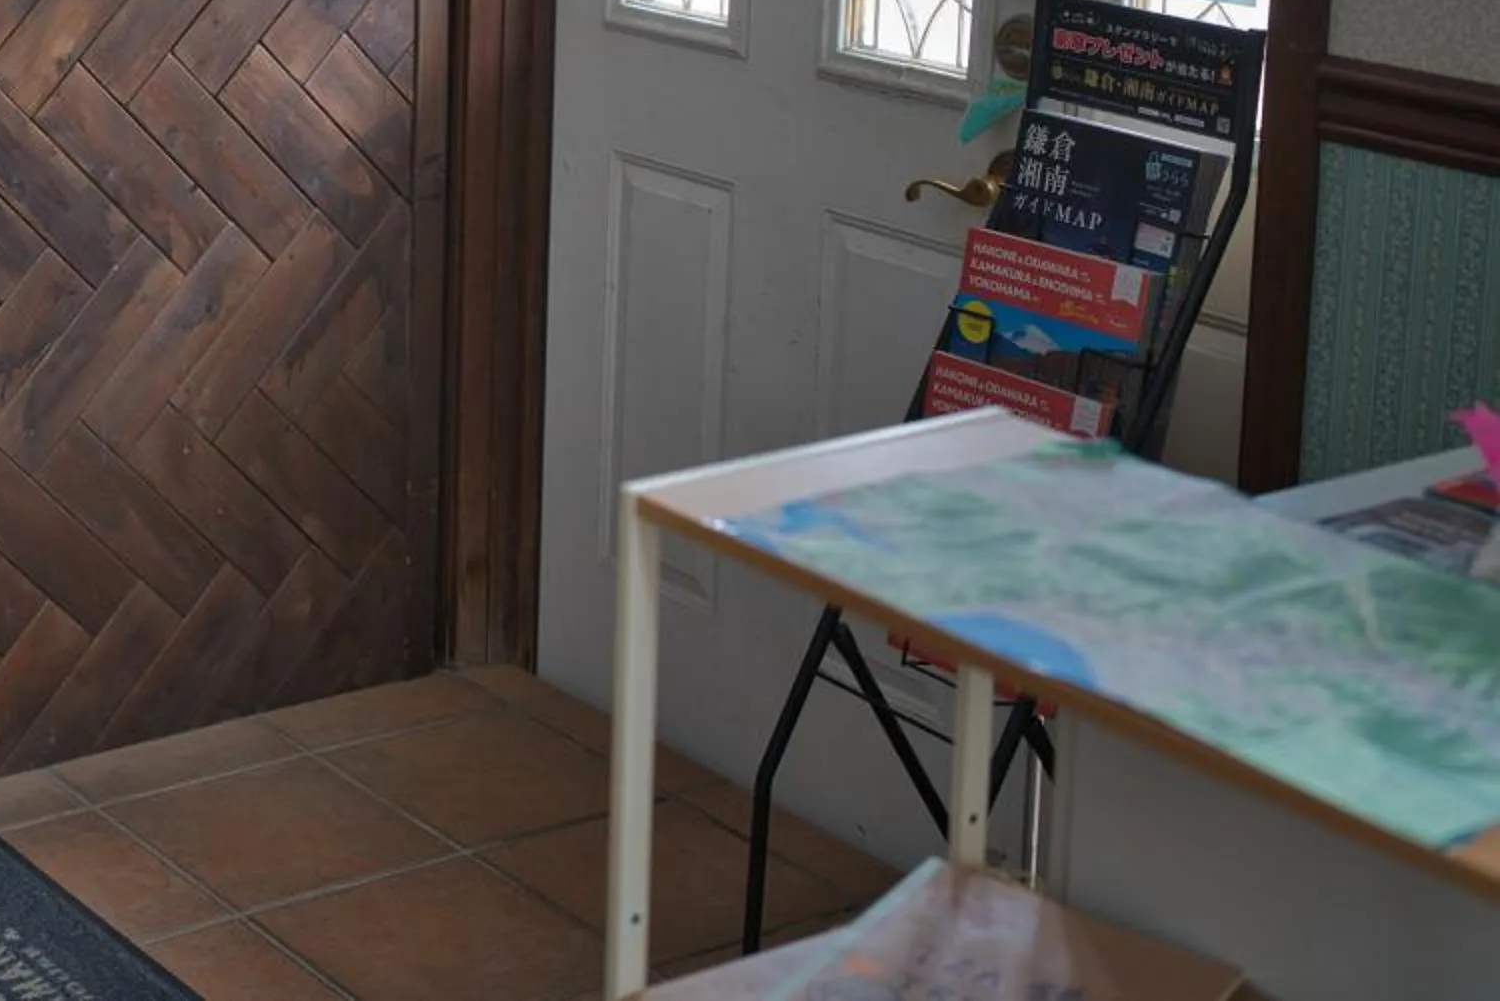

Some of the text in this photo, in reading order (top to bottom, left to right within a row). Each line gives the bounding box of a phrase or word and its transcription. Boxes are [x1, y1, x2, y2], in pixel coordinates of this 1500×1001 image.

[1023, 123, 1077, 163] 鎌倉
[1017, 157, 1071, 197] 湘南
[969, 258, 1032, 285] KAMAKURA
